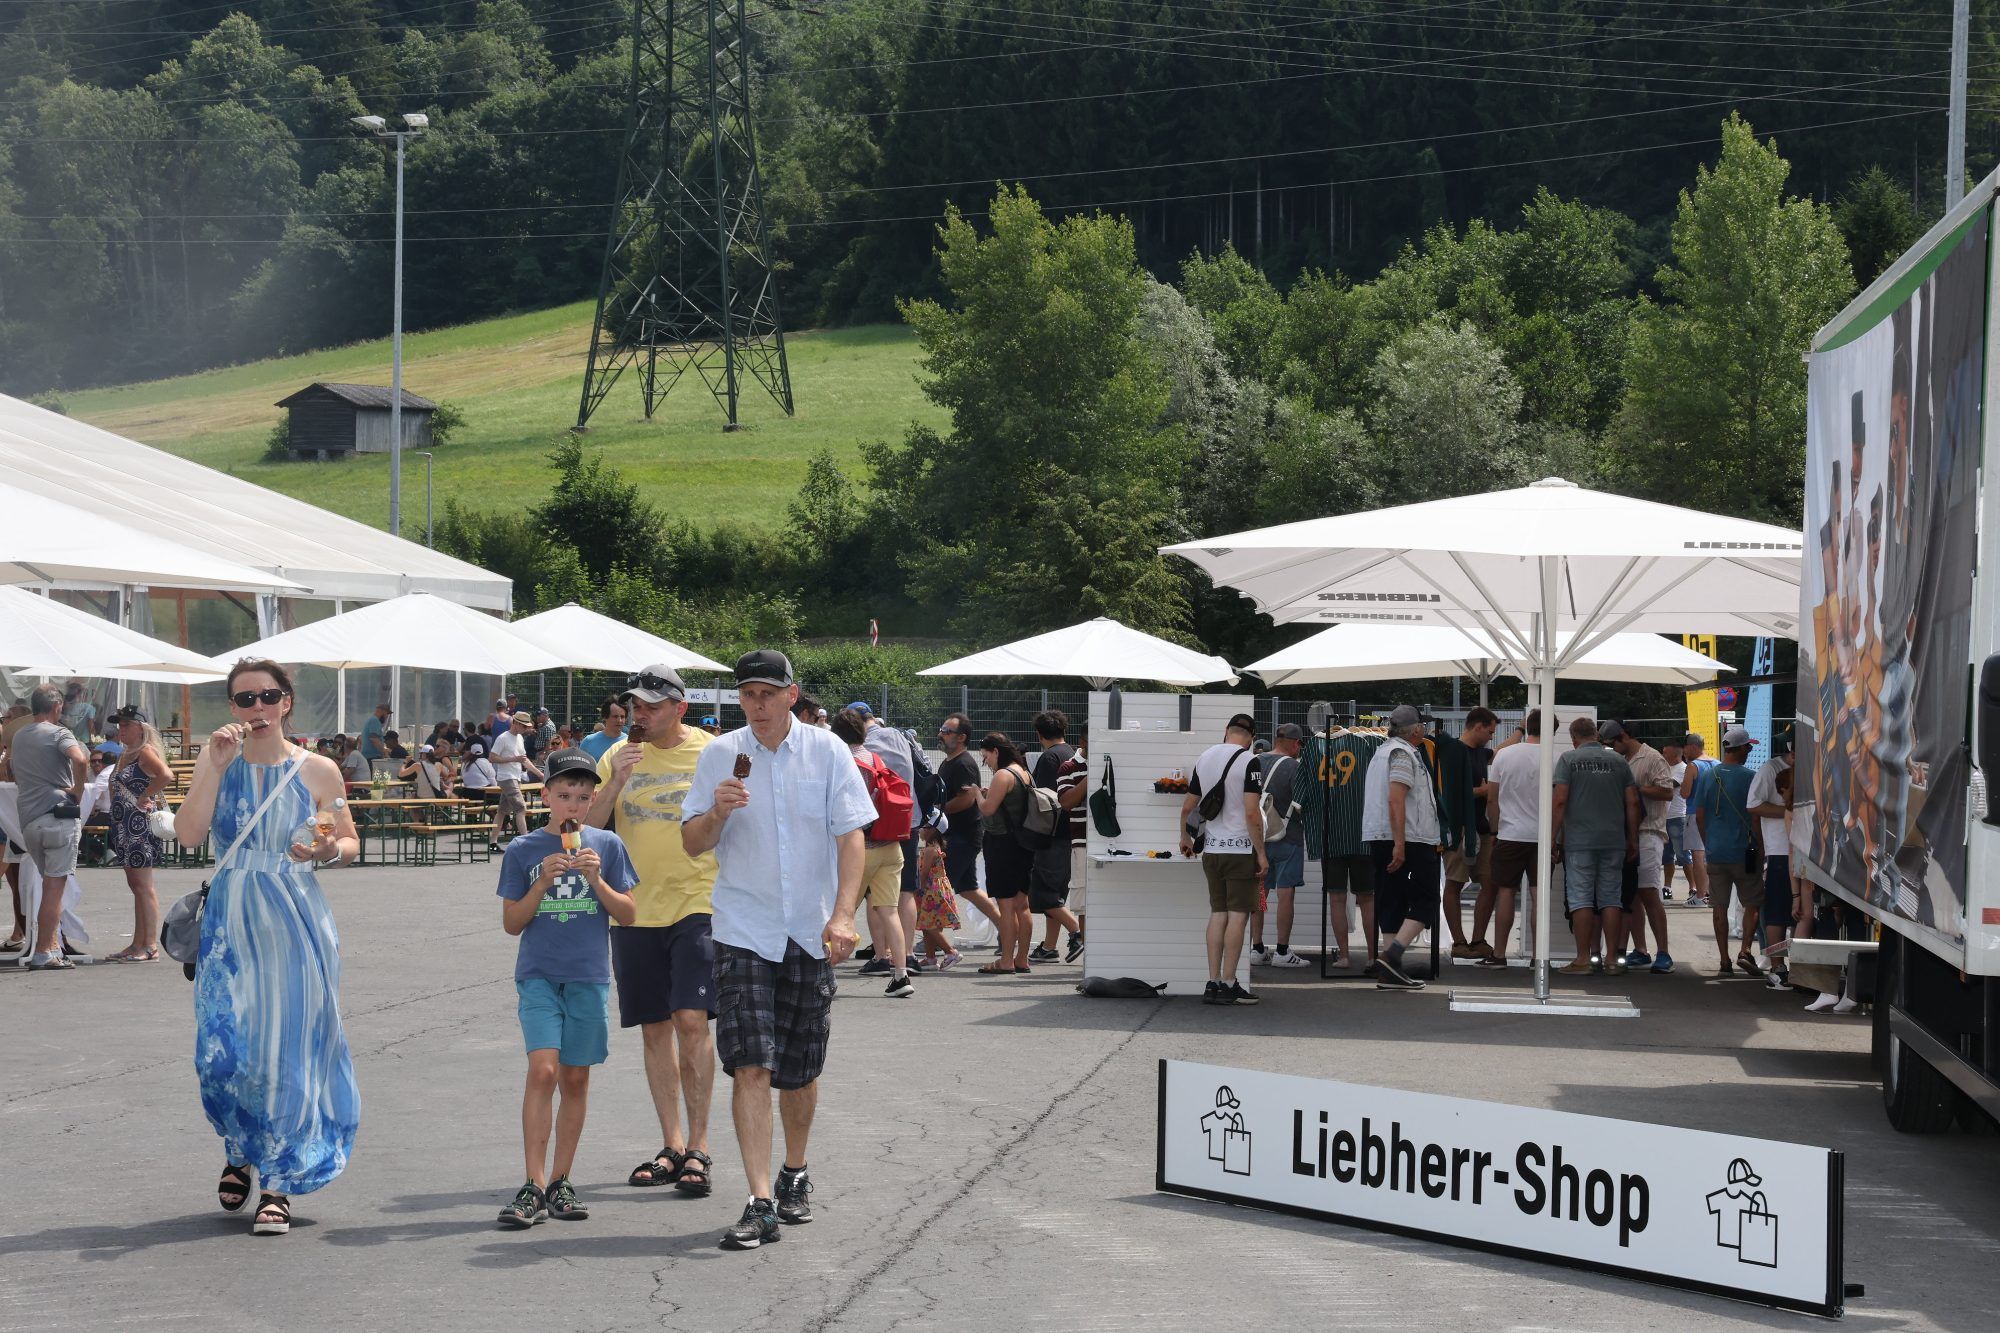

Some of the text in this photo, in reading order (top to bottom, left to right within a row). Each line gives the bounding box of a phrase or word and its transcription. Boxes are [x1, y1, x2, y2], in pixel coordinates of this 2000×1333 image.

[1318, 751, 1356, 788] 49
[1218, 838, 1252, 848] STOP
[1292, 1109, 1650, 1248] Liebherr-Shop
